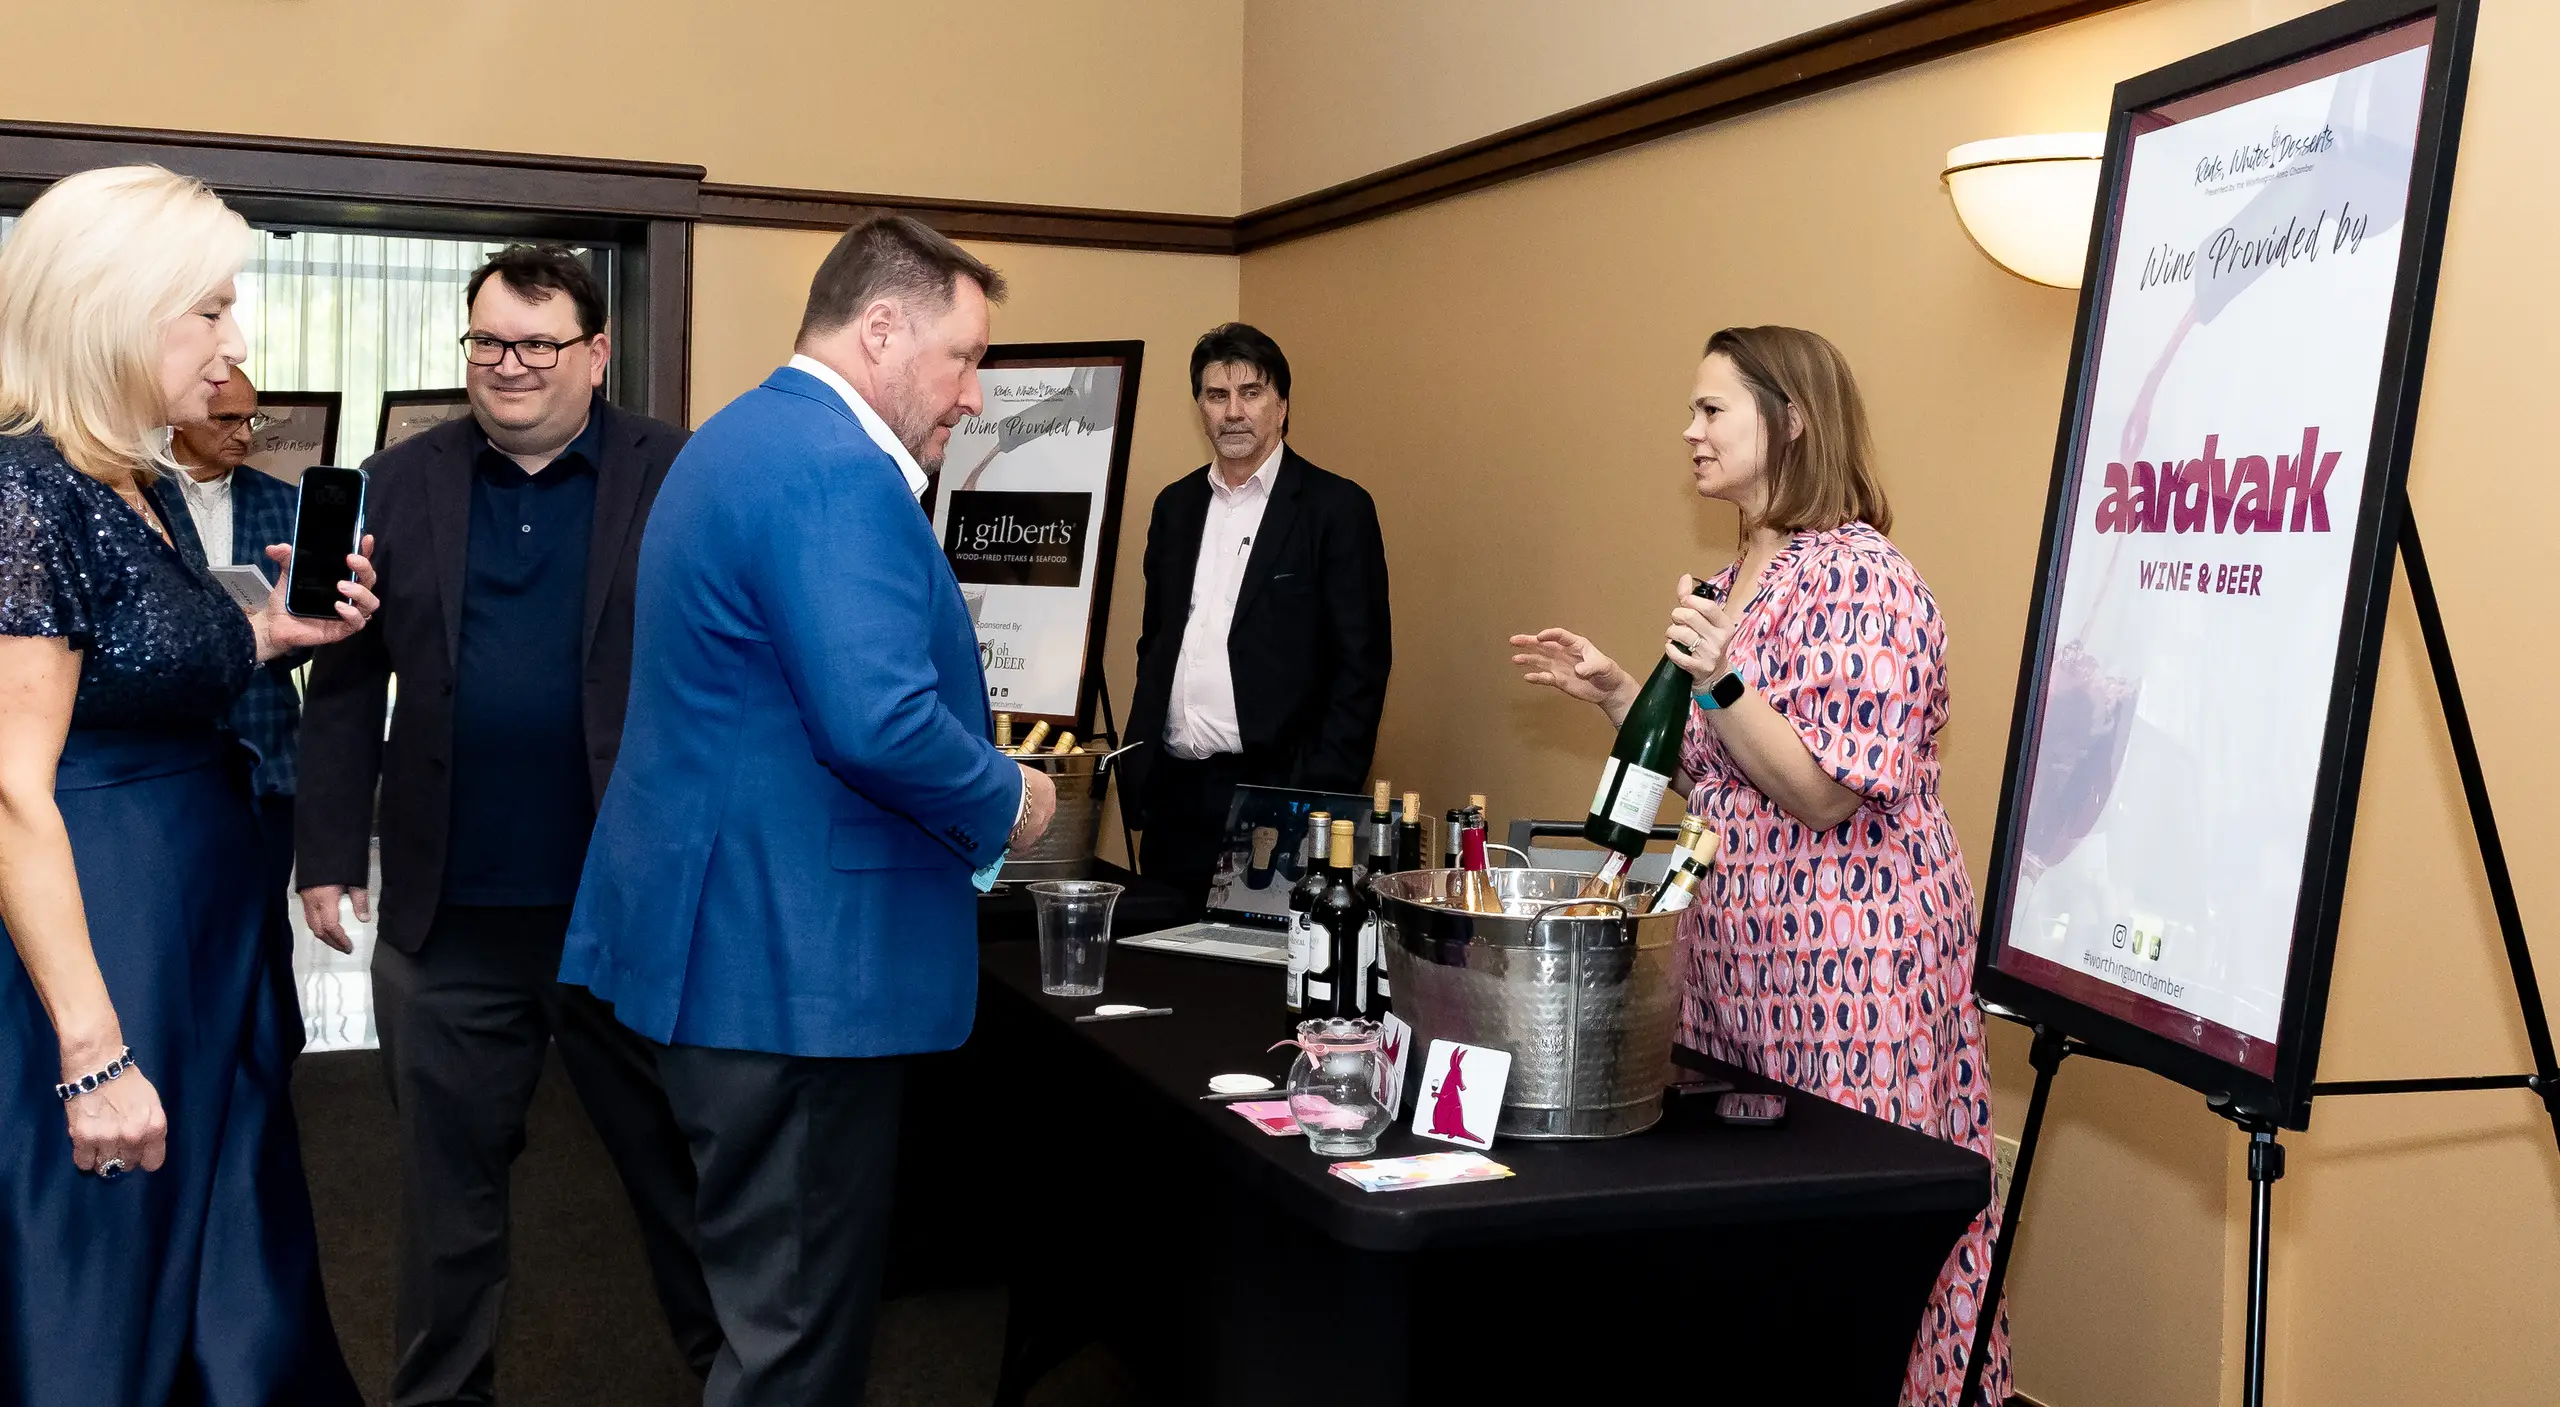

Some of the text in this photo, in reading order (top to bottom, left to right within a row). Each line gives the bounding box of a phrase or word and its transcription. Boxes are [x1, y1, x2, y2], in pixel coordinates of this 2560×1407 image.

[2194, 124, 2335, 187] Reds, Whites Desserts
[2140, 201, 2368, 291] Wine Provided by
[964, 415, 1096, 436] Wine Provided by
[2095, 426, 2343, 535] aardvark
[955, 515, 1073, 550] j. gilbert's
[956, 553, 1067, 563] WOOD-FIRED STEAKS & SEAFOOD
[2140, 560, 2263, 596] WINE & BEER
[975, 620, 1011, 631] Sponsored
[994, 656, 1025, 670] DEER
[996, 642, 1009, 656] oh
[2083, 950, 2185, 999] #worthingtonchamber
